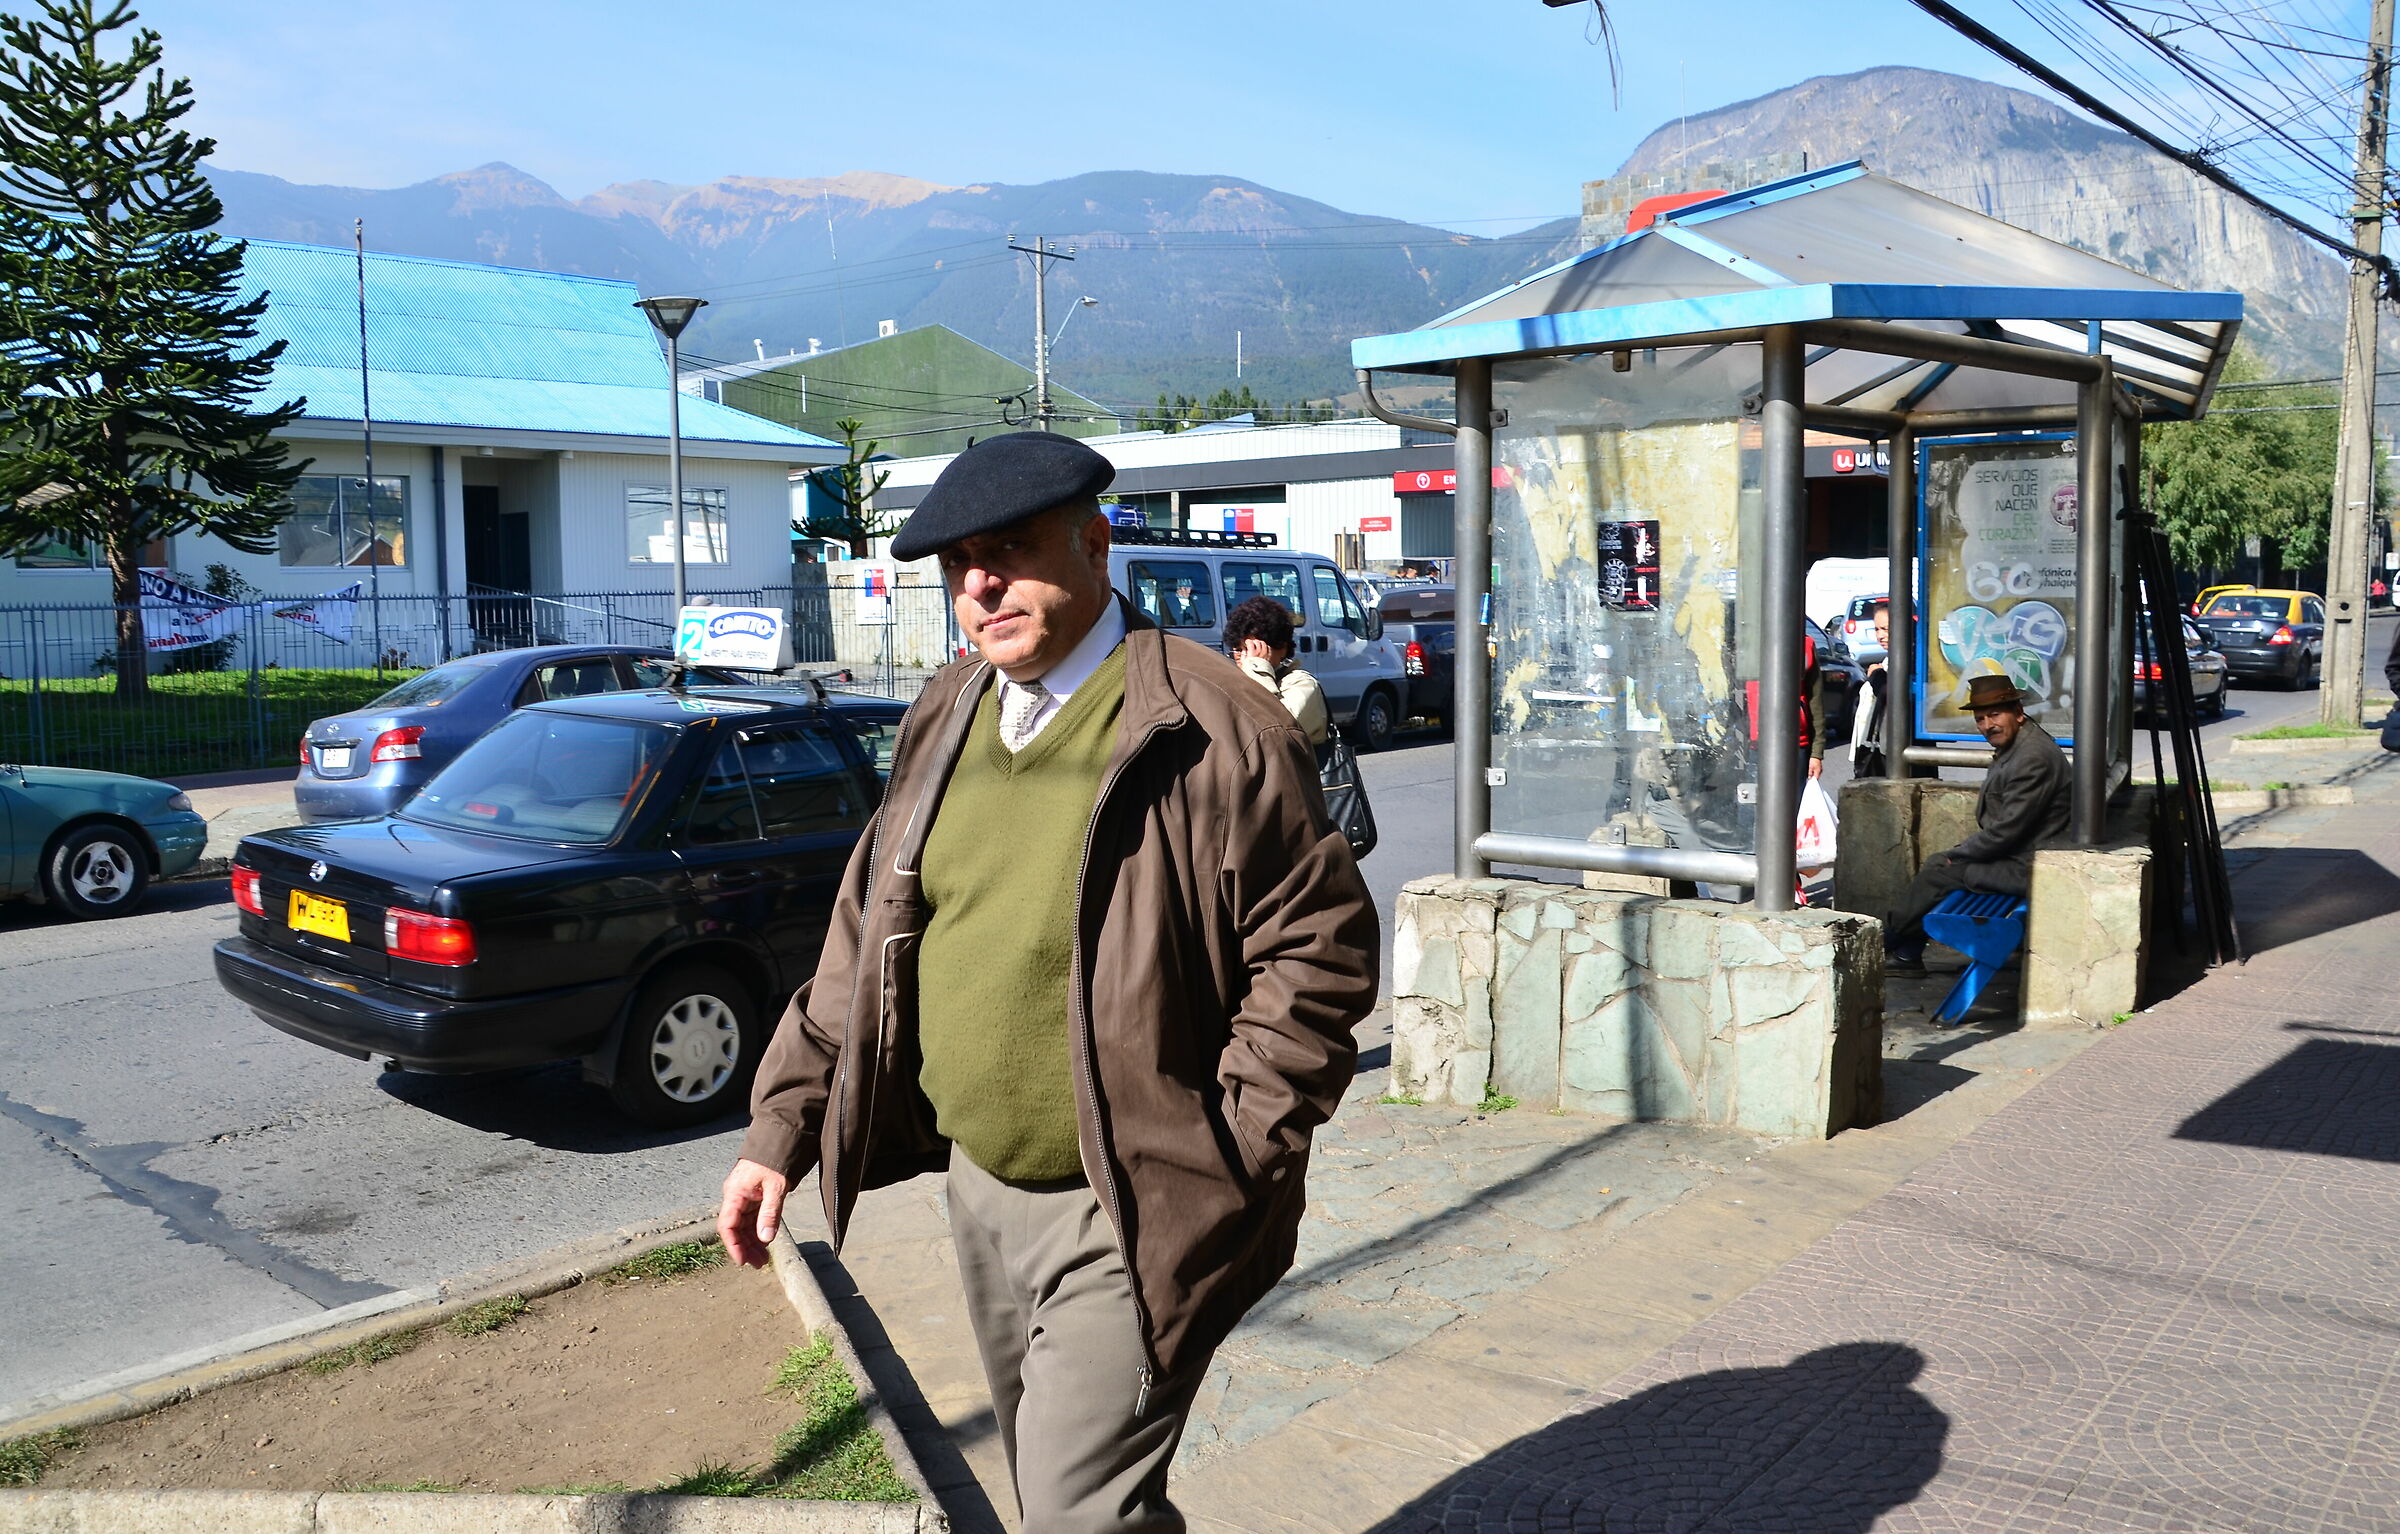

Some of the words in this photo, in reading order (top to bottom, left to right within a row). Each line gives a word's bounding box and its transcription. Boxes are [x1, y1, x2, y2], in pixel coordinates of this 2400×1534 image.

[1976, 469, 2038, 483] SERVICIOS
[2012, 484, 2038, 497] QUE
[1995, 499, 2038, 511] NACEN
[2013, 513, 2037, 526] DEL
[681, 621, 704, 660] 2
